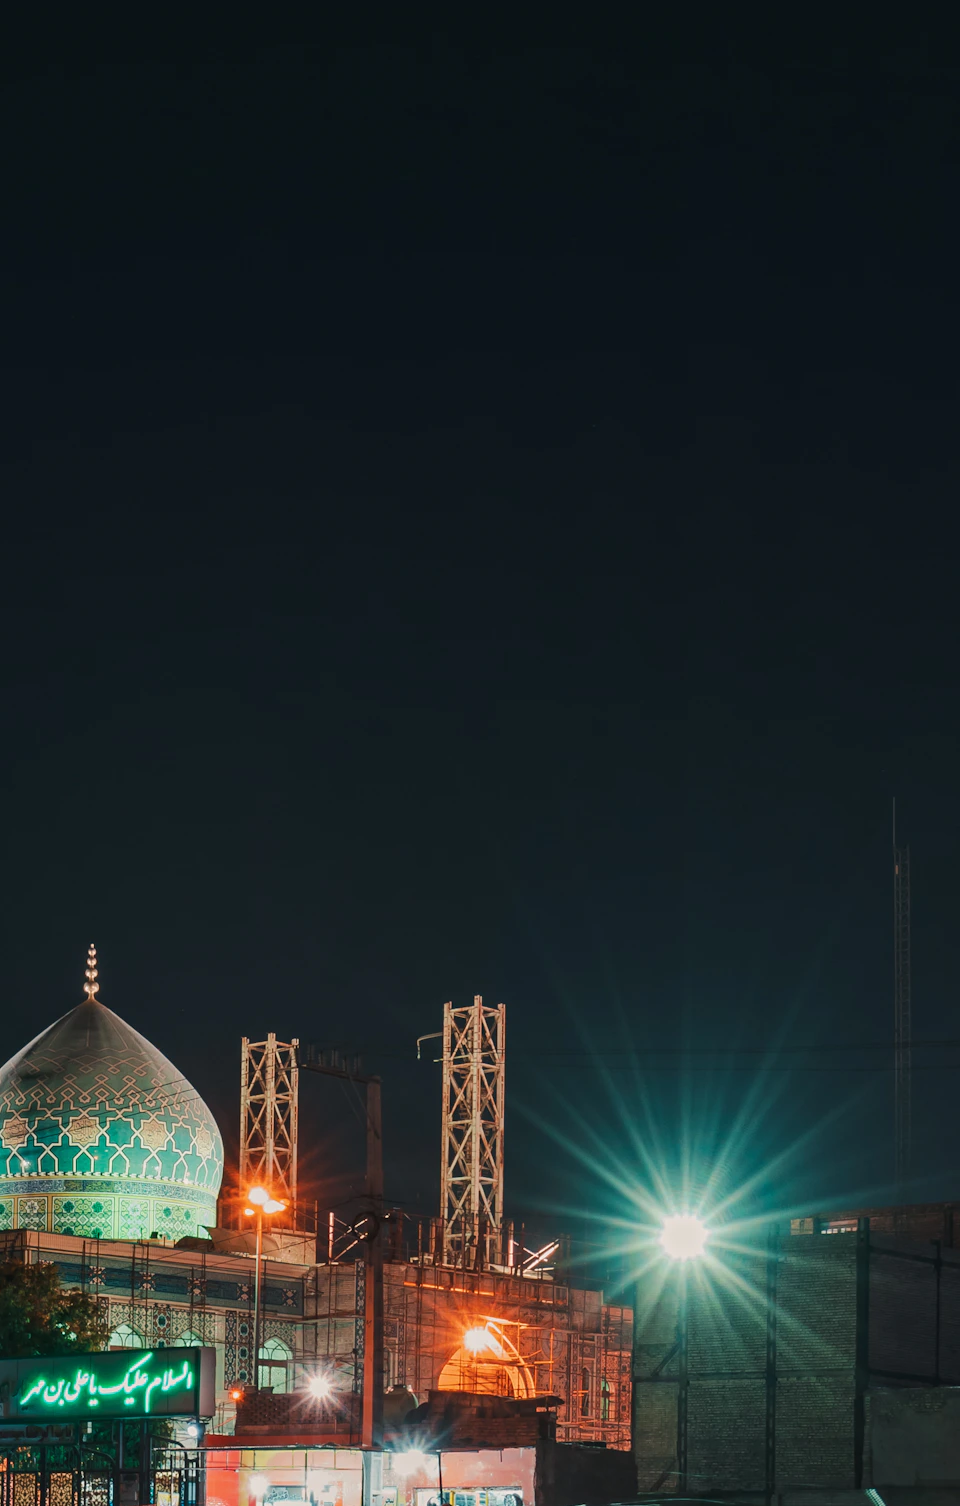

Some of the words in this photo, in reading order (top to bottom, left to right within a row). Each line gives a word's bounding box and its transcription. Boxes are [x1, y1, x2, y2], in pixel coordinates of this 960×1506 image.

[43, 1379, 65, 1406] بن
[64, 1369, 89, 1402] علی
[88, 1374, 99, 1406] یا
[98, 1352, 152, 1405] علیک
[145, 1361, 192, 1413] السلام
